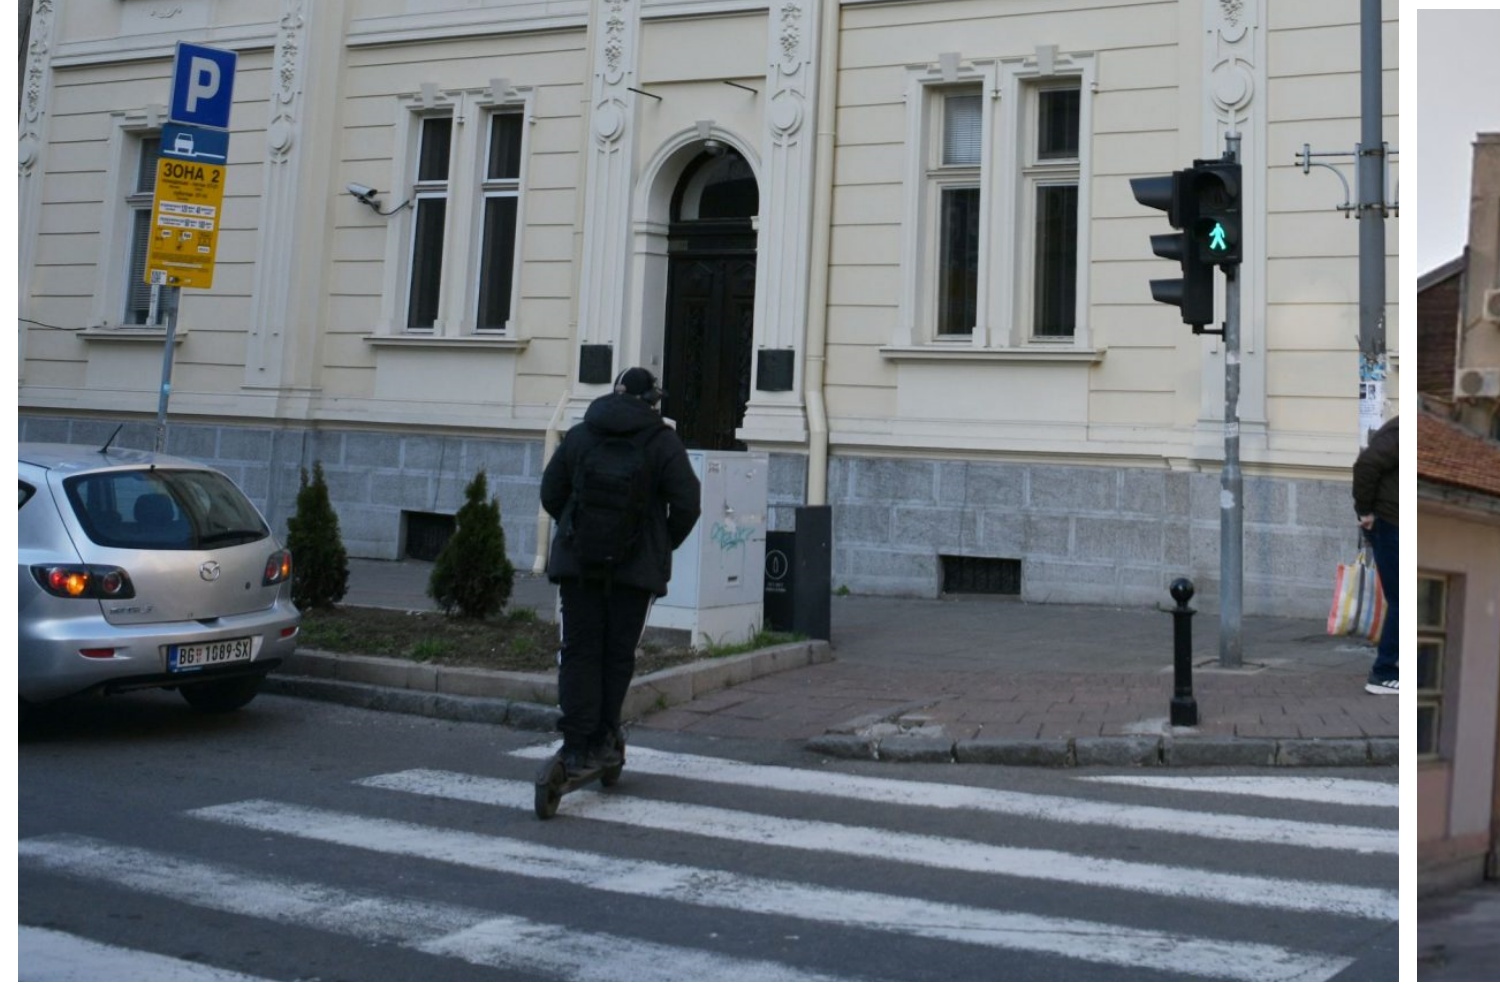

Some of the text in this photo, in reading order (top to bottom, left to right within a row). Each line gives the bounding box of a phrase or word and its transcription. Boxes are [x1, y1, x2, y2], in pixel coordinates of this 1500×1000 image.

[185, 56, 221, 113] P
[163, 162, 204, 181] ЗОНА
[211, 169, 220, 183] 2
[180, 647, 195, 665] BG
